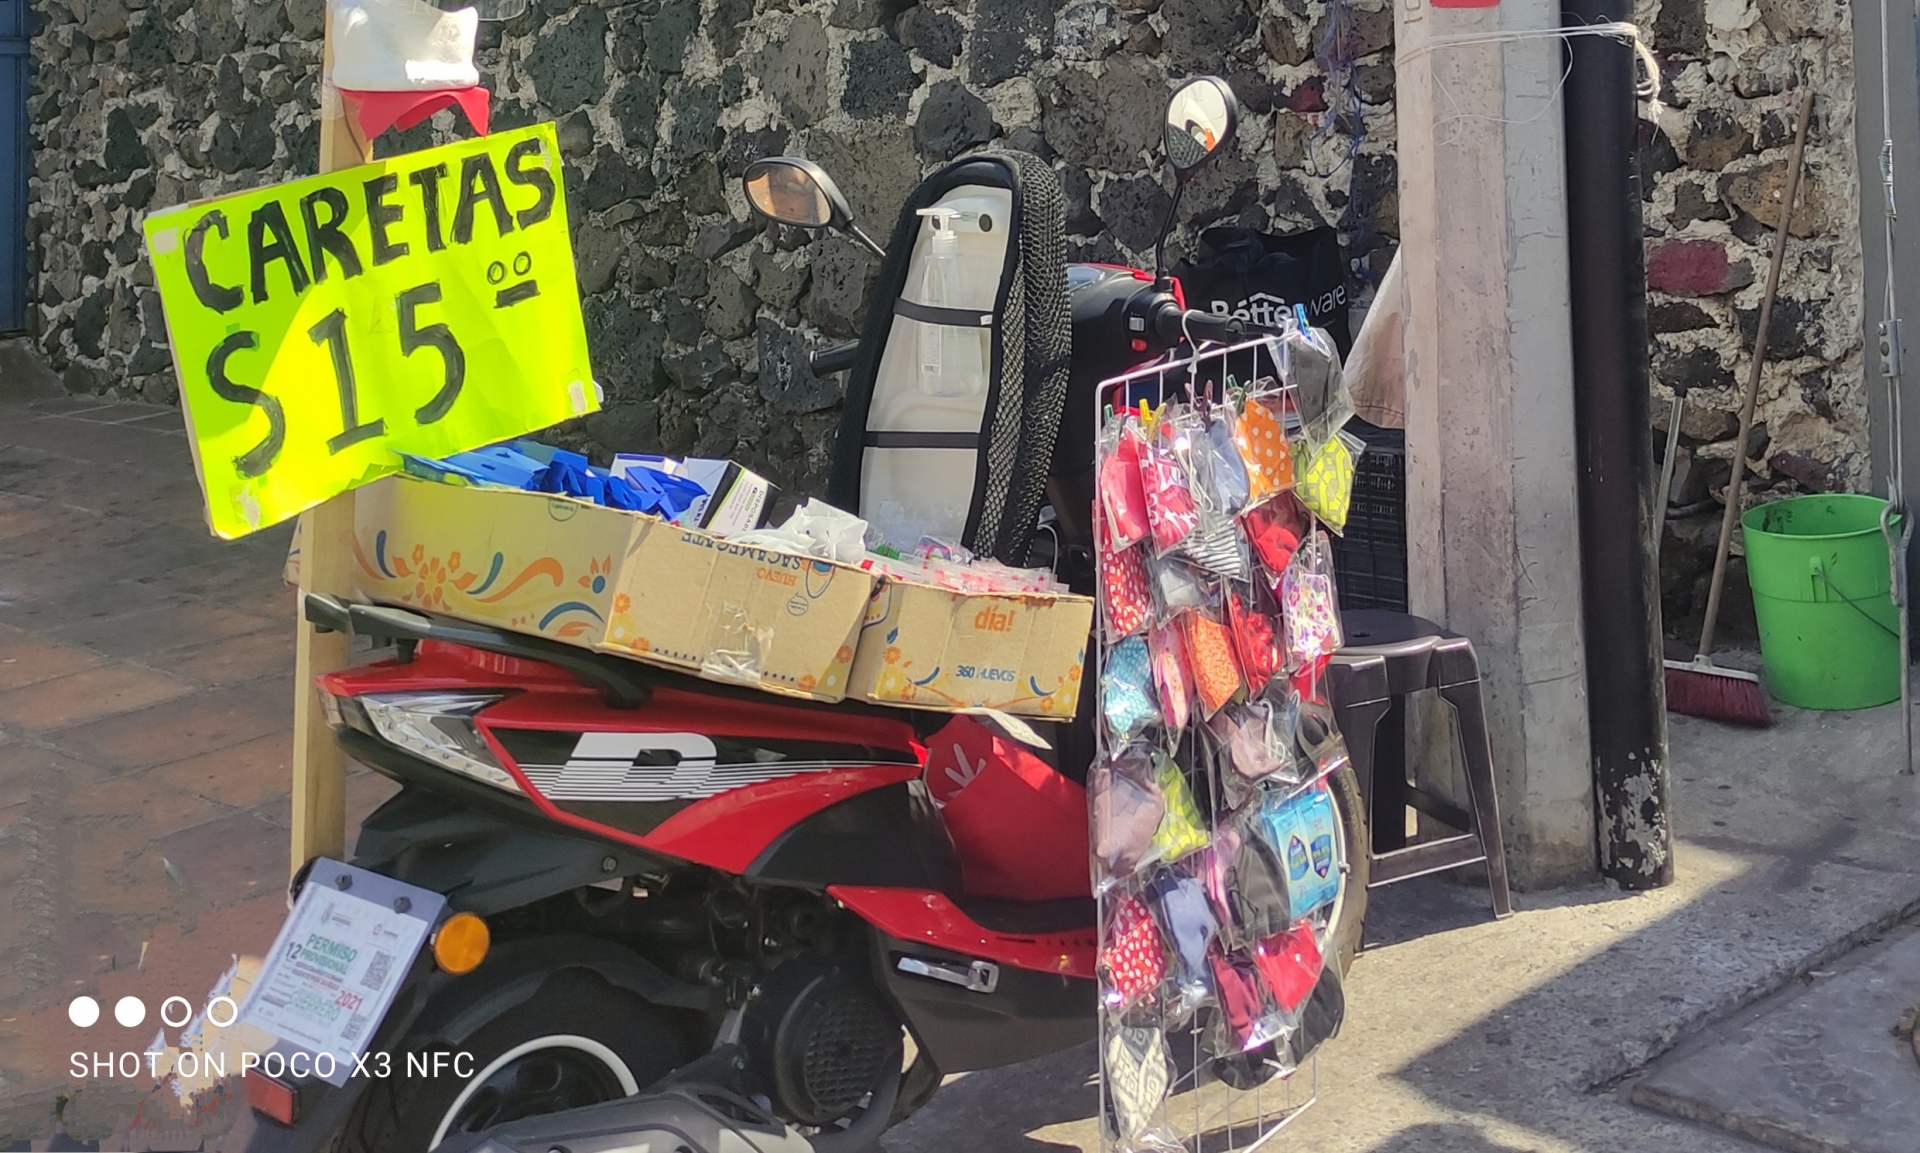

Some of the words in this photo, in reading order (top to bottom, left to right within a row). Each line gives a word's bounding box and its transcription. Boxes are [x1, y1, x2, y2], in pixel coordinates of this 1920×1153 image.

[184, 137, 556, 314] CARETAS
[757, 567, 798, 586] HUEVO
[974, 605, 1016, 632] día!
[955, 665, 975, 679] 360
[976, 667, 1016, 682] HUEVOS
[286, 941, 303, 960] 12
[306, 933, 358, 963] PERMISO
[299, 949, 350, 976] PROVISIONAL
[291, 991, 341, 1021] GUERRERO
[335, 989, 364, 1010] 2021
